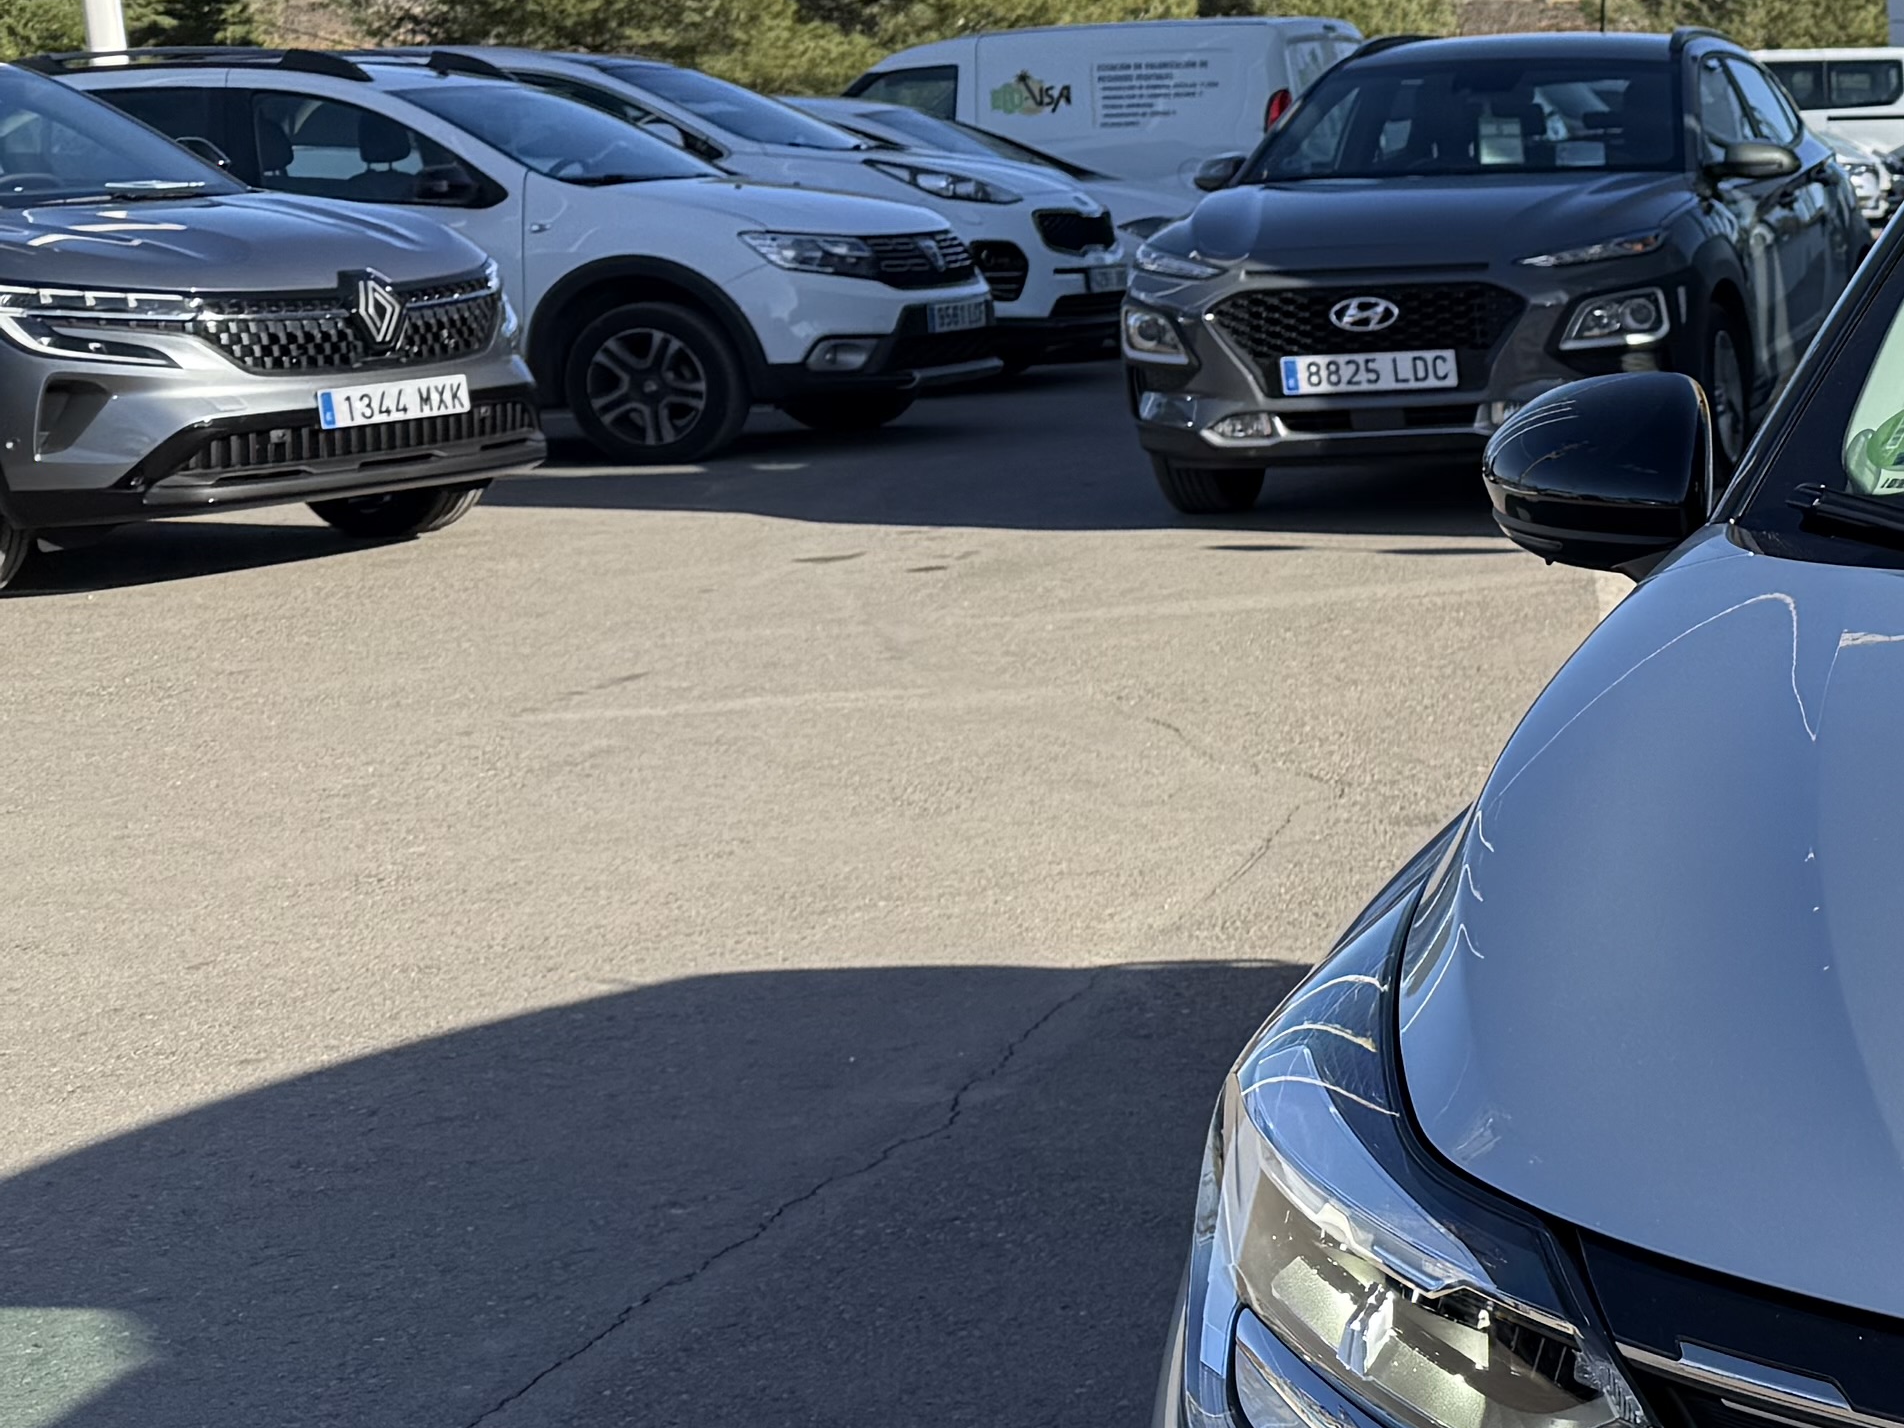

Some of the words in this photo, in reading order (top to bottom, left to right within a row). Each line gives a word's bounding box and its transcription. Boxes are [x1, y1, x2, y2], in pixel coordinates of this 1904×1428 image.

[1306, 357, 1381, 387] 8825
[1391, 355, 1450, 383] LDC
[343, 388, 409, 422] 1344
[417, 382, 465, 413] MXK
